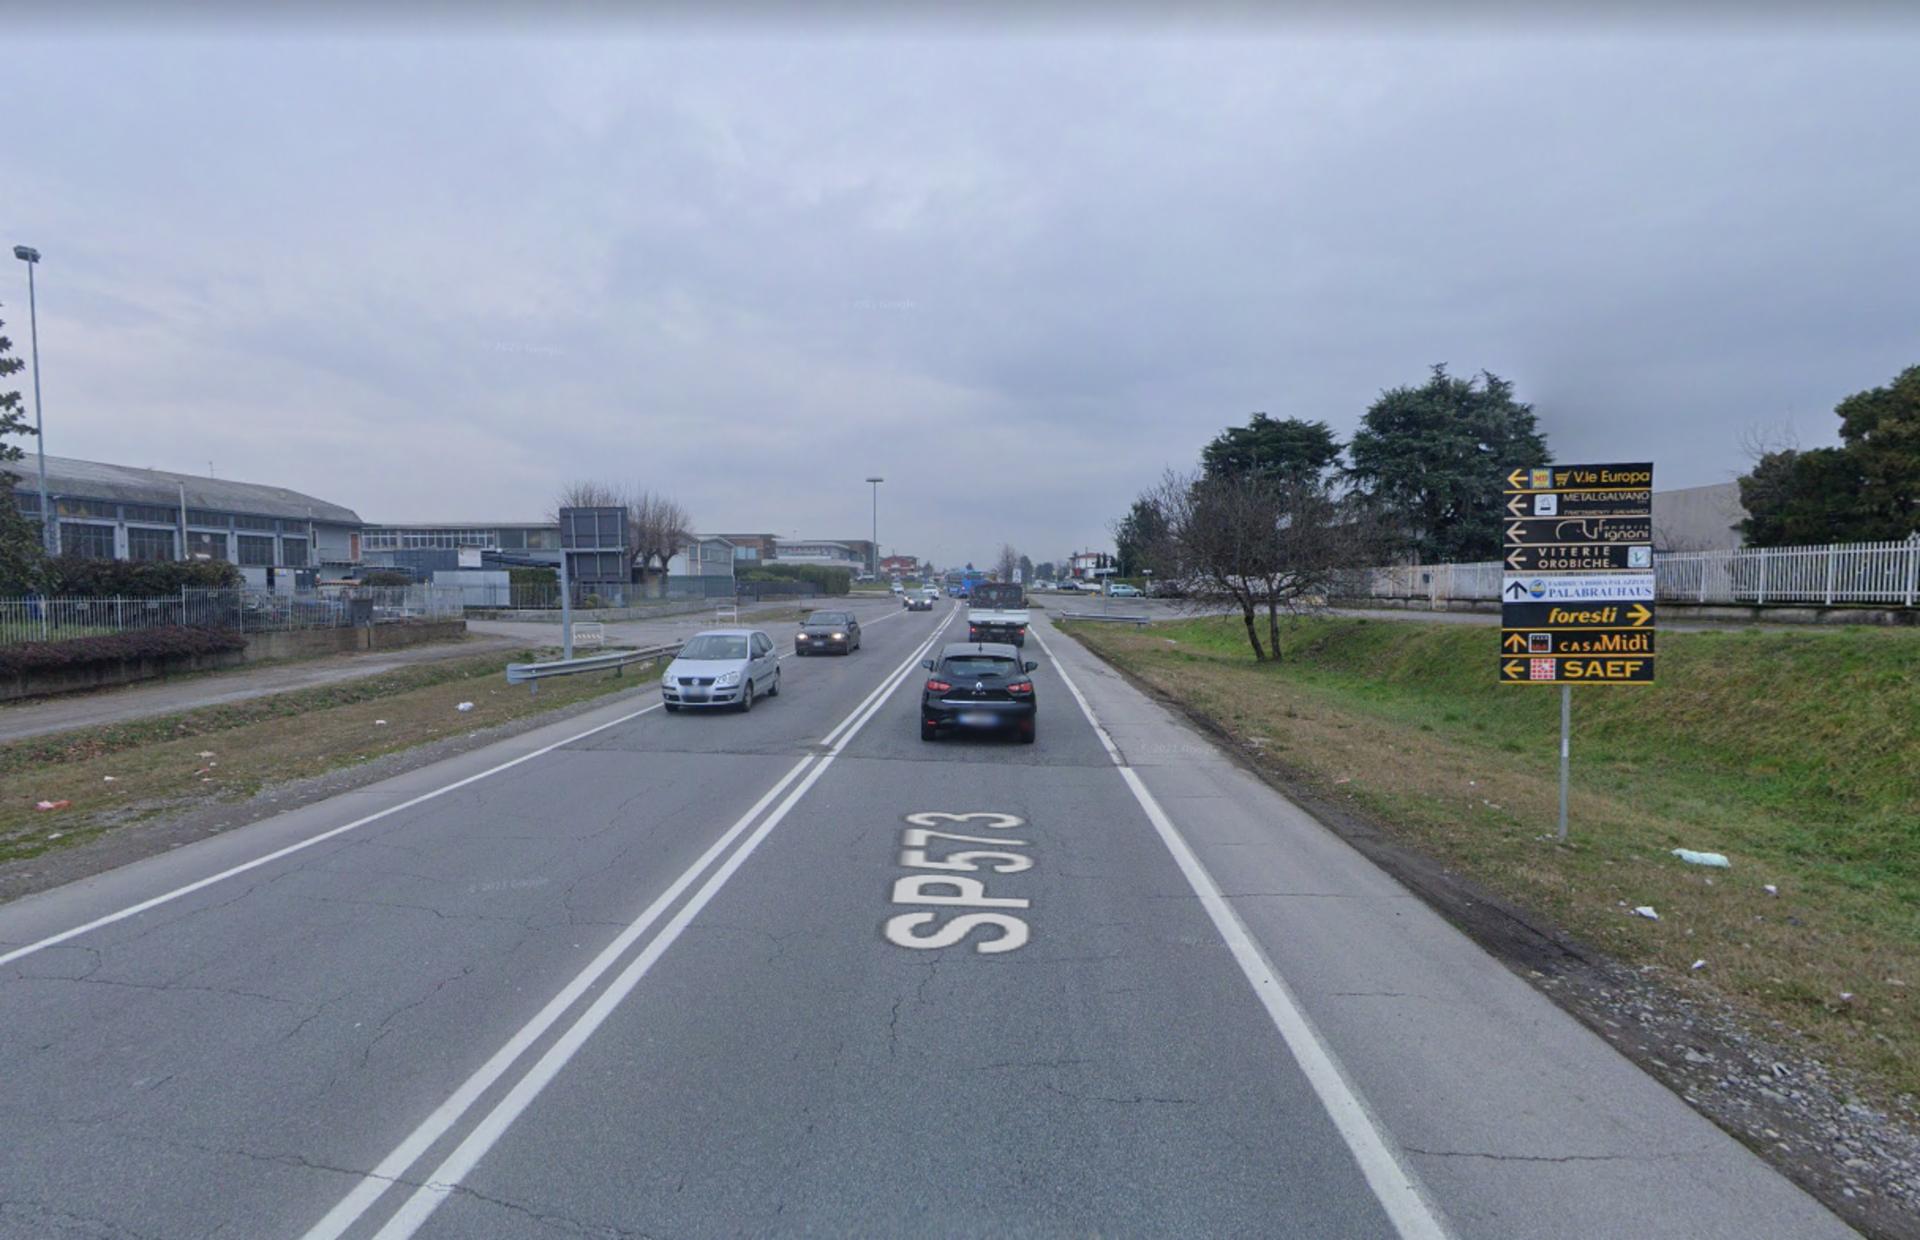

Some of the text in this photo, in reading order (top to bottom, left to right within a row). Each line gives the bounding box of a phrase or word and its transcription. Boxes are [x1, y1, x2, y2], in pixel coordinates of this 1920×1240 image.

[1601, 470, 1650, 485] Europa
[1563, 492, 1650, 502] METALGALVANO
[1538, 546, 1611, 556] VITERIE
[1538, 558, 1611, 568] OROBICHE
[1549, 586, 1652, 598] PALABRAUHAUS
[1548, 607, 1618, 623] foresti
[1564, 660, 1644, 678] SAEF
